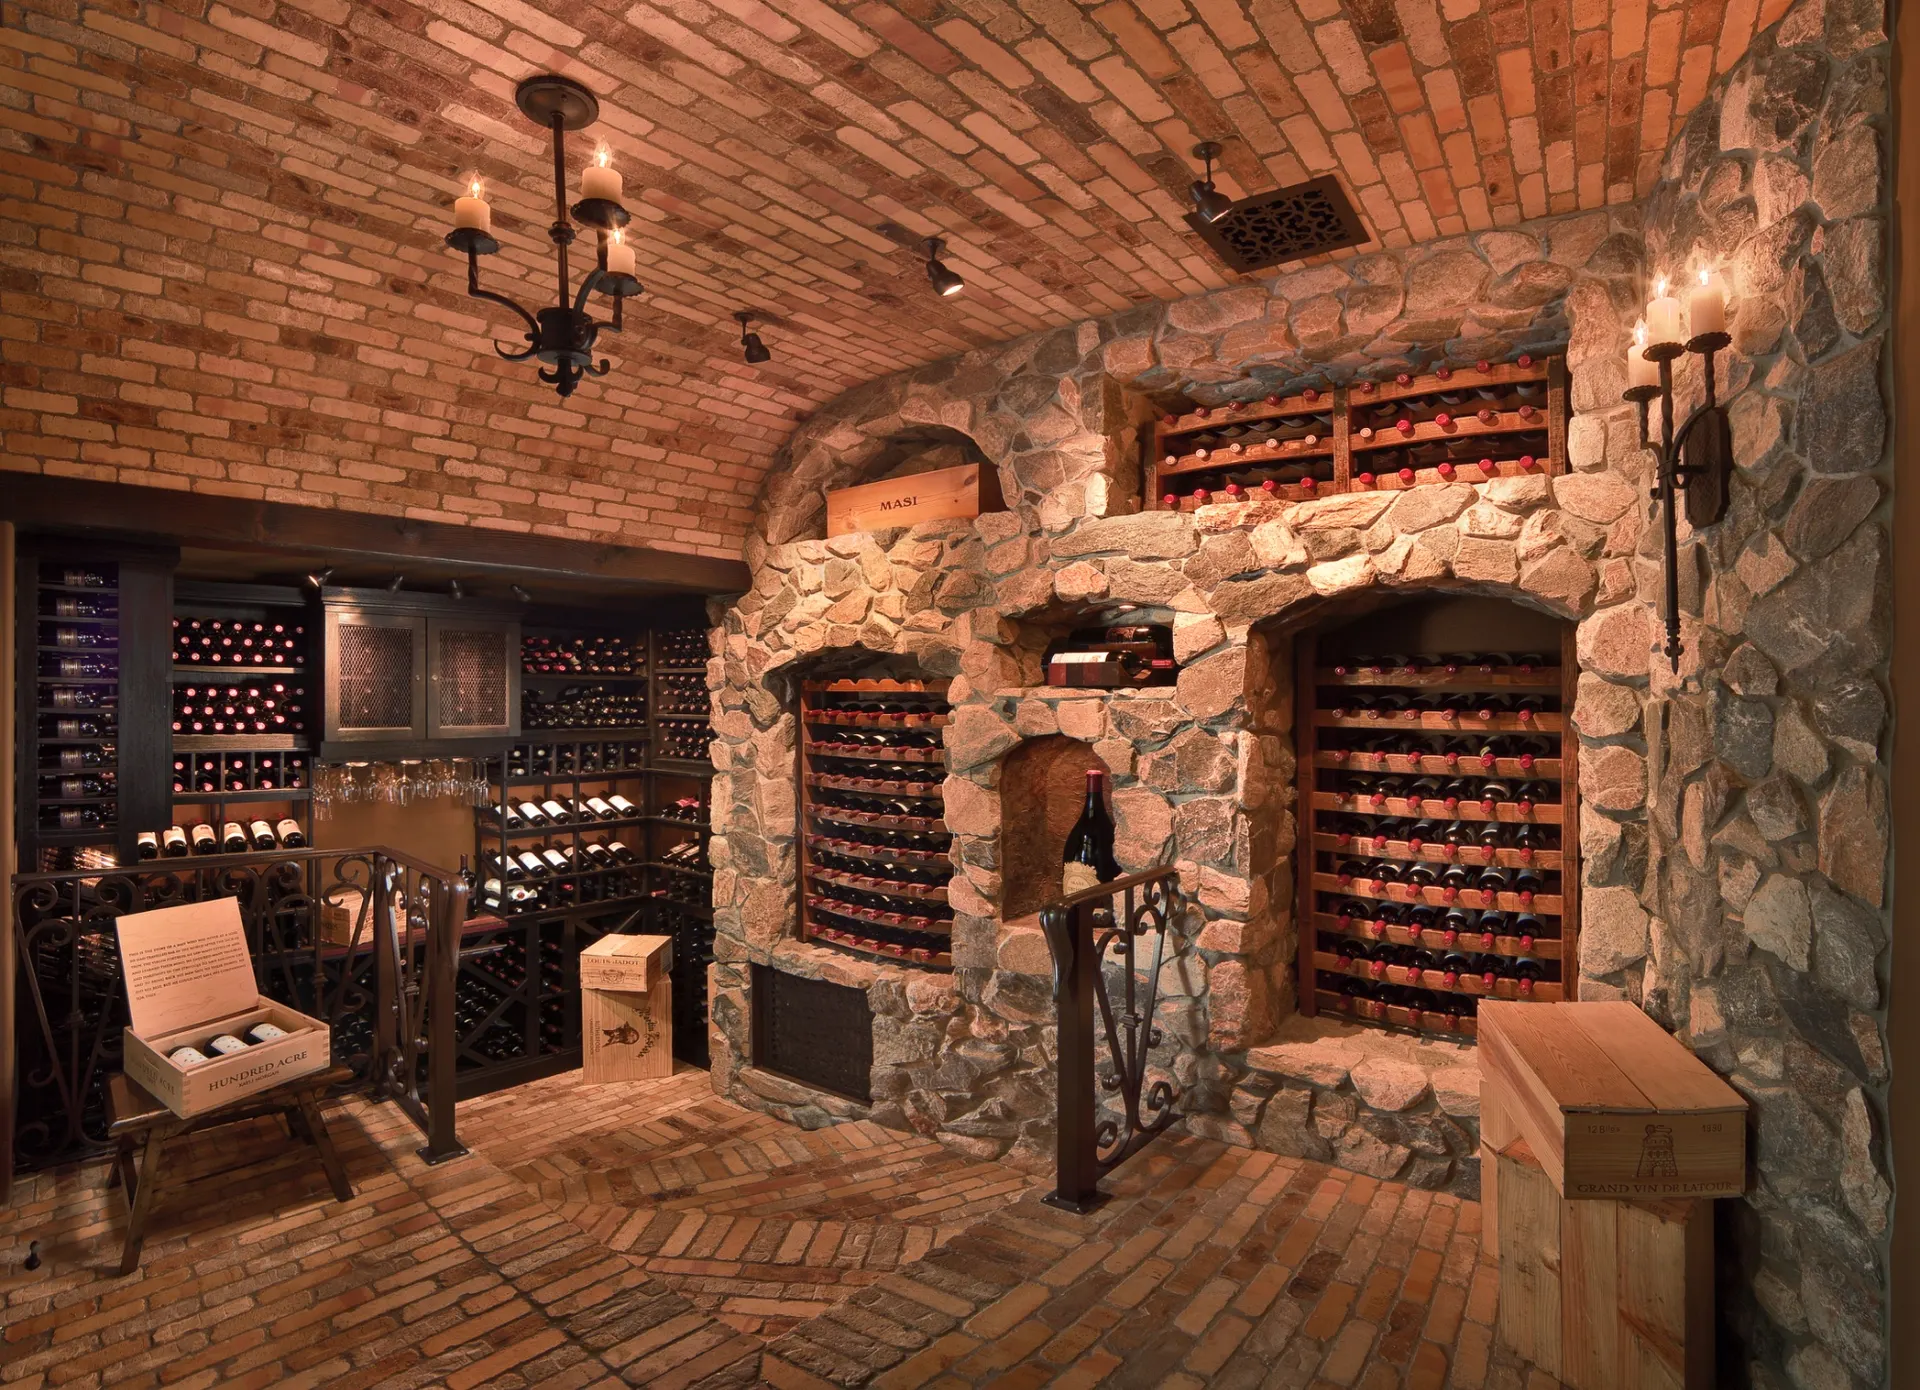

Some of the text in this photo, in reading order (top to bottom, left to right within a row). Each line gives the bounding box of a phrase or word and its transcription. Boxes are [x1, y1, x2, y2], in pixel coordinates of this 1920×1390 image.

[879, 496, 918, 512] MASI
[208, 1050, 308, 1092] HUNDRED ACRE
[1577, 1182, 1733, 1193] GRAND VIN DE LATOUR
